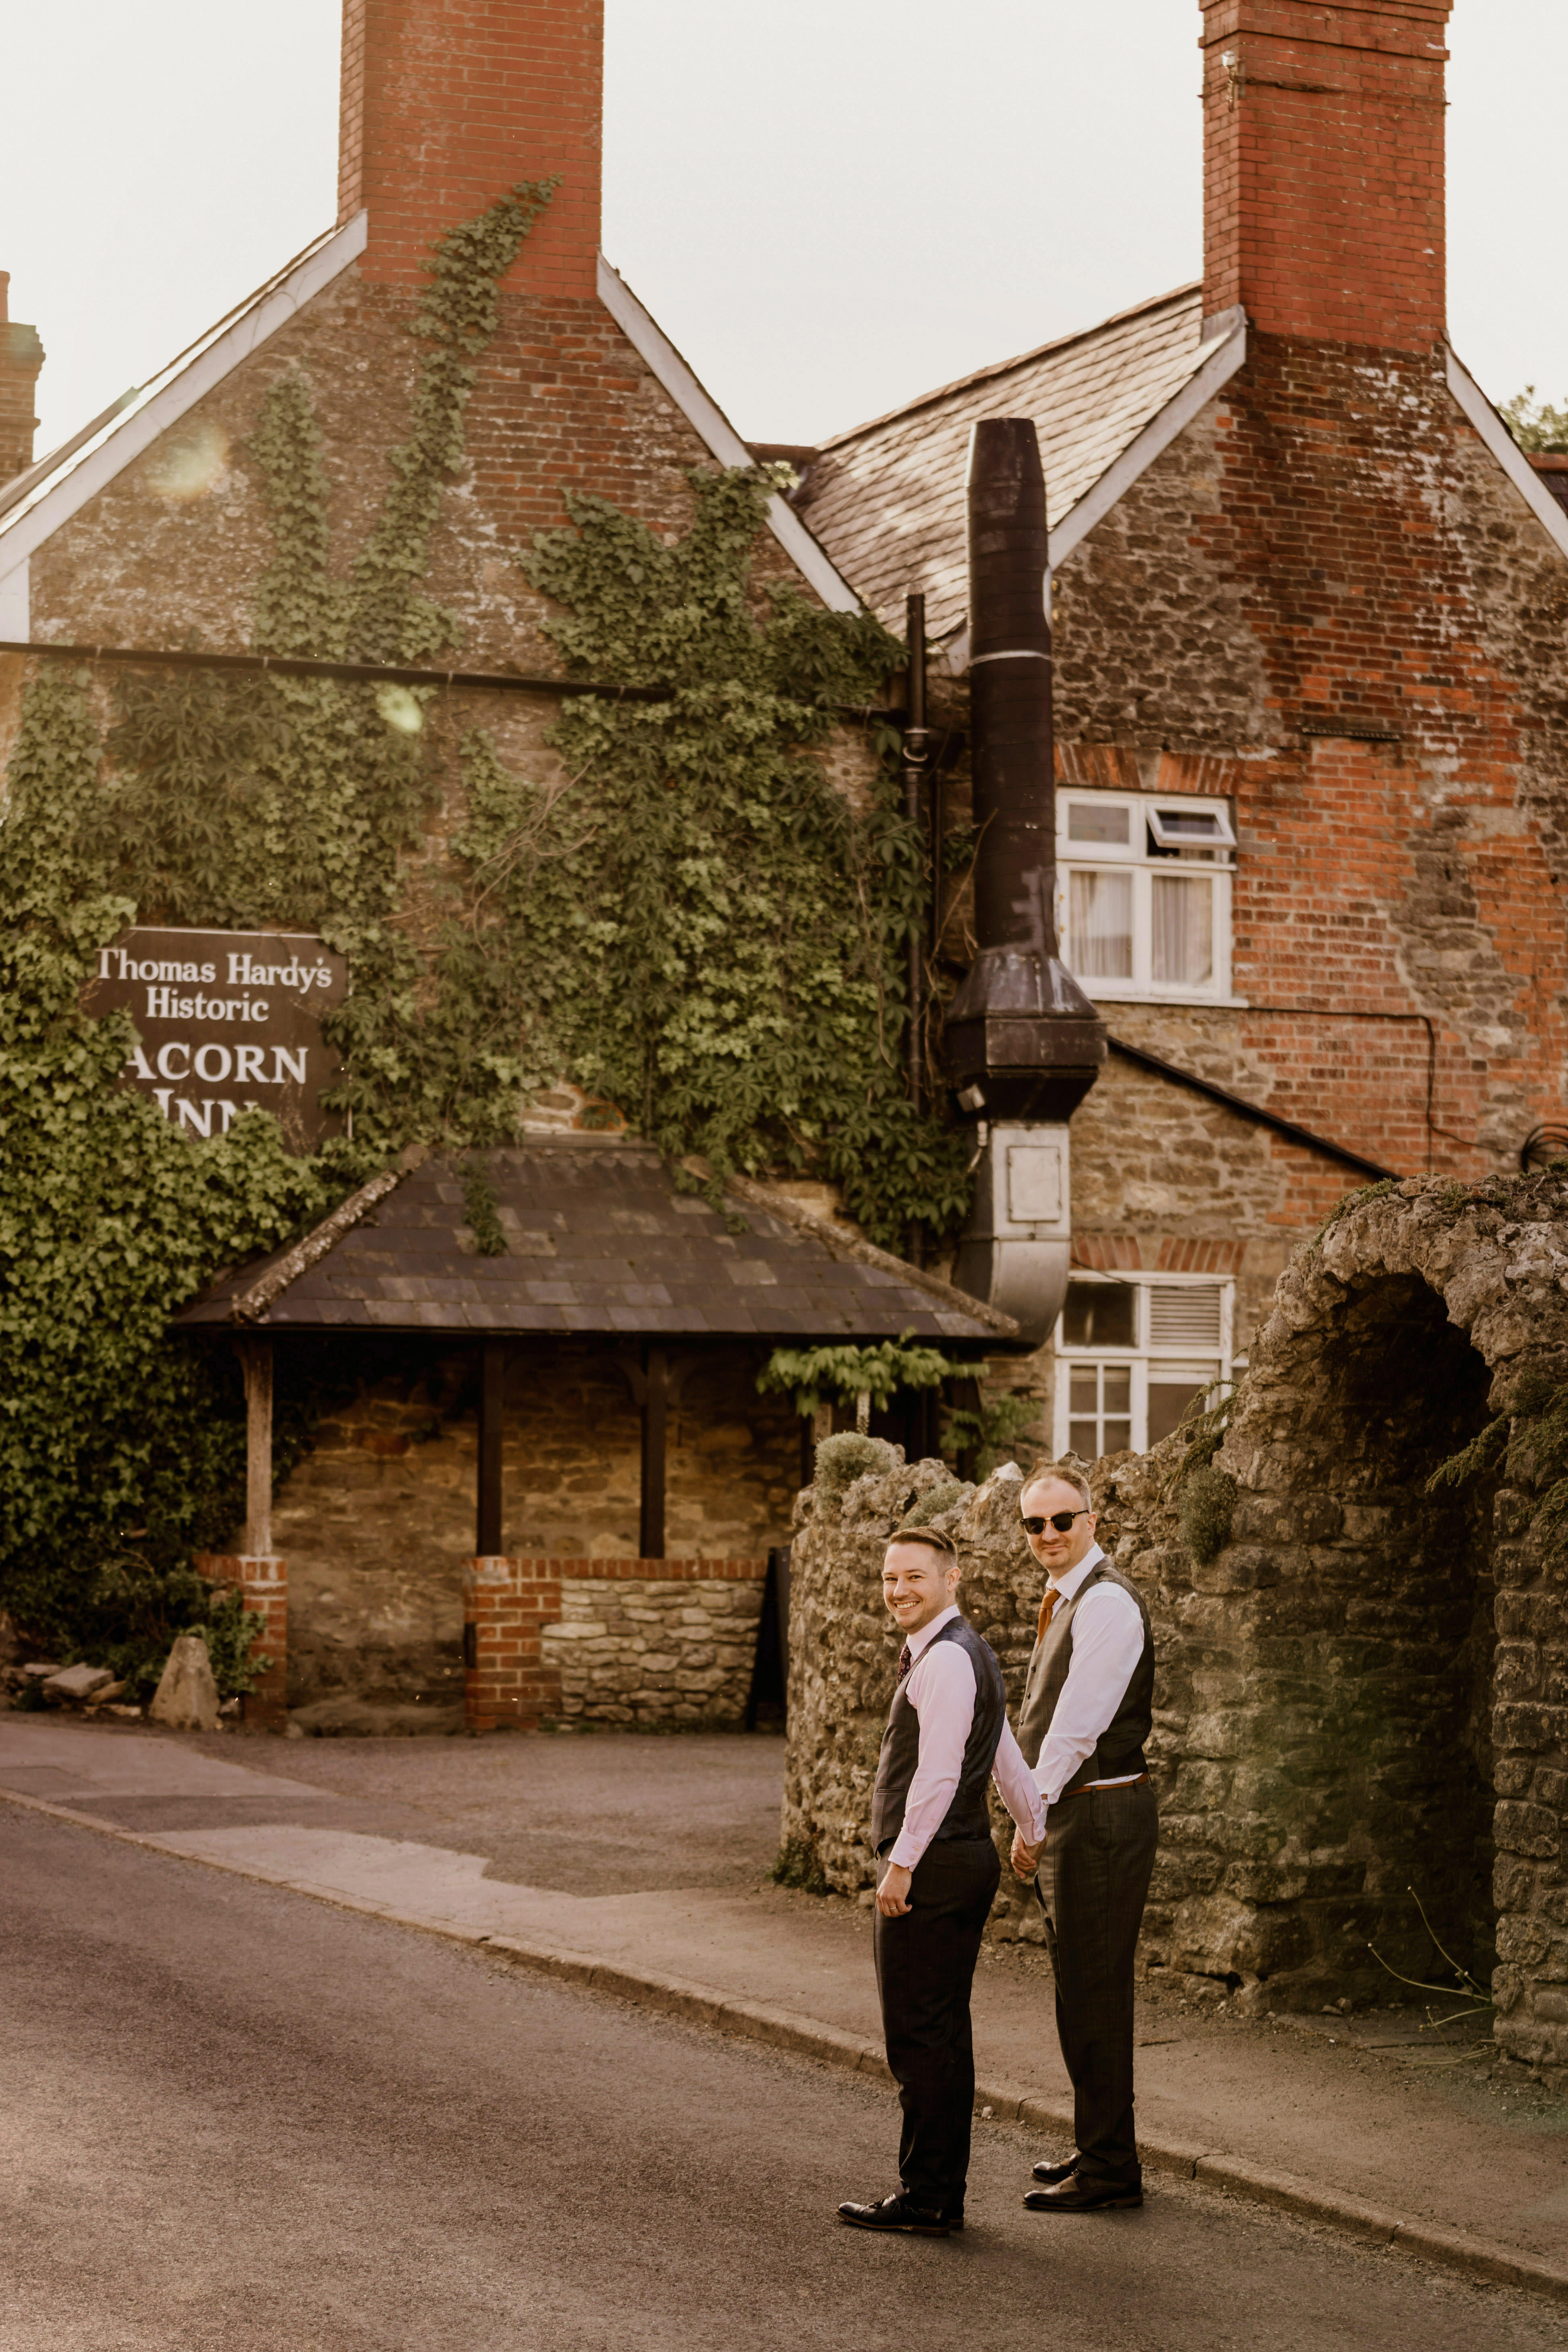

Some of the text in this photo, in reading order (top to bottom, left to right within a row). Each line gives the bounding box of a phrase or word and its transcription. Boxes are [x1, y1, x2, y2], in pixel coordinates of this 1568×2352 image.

[96, 948, 332, 994] Thomas Hardy's
[146, 986, 269, 1022] Historic
[118, 1042, 308, 1084] ACORN
